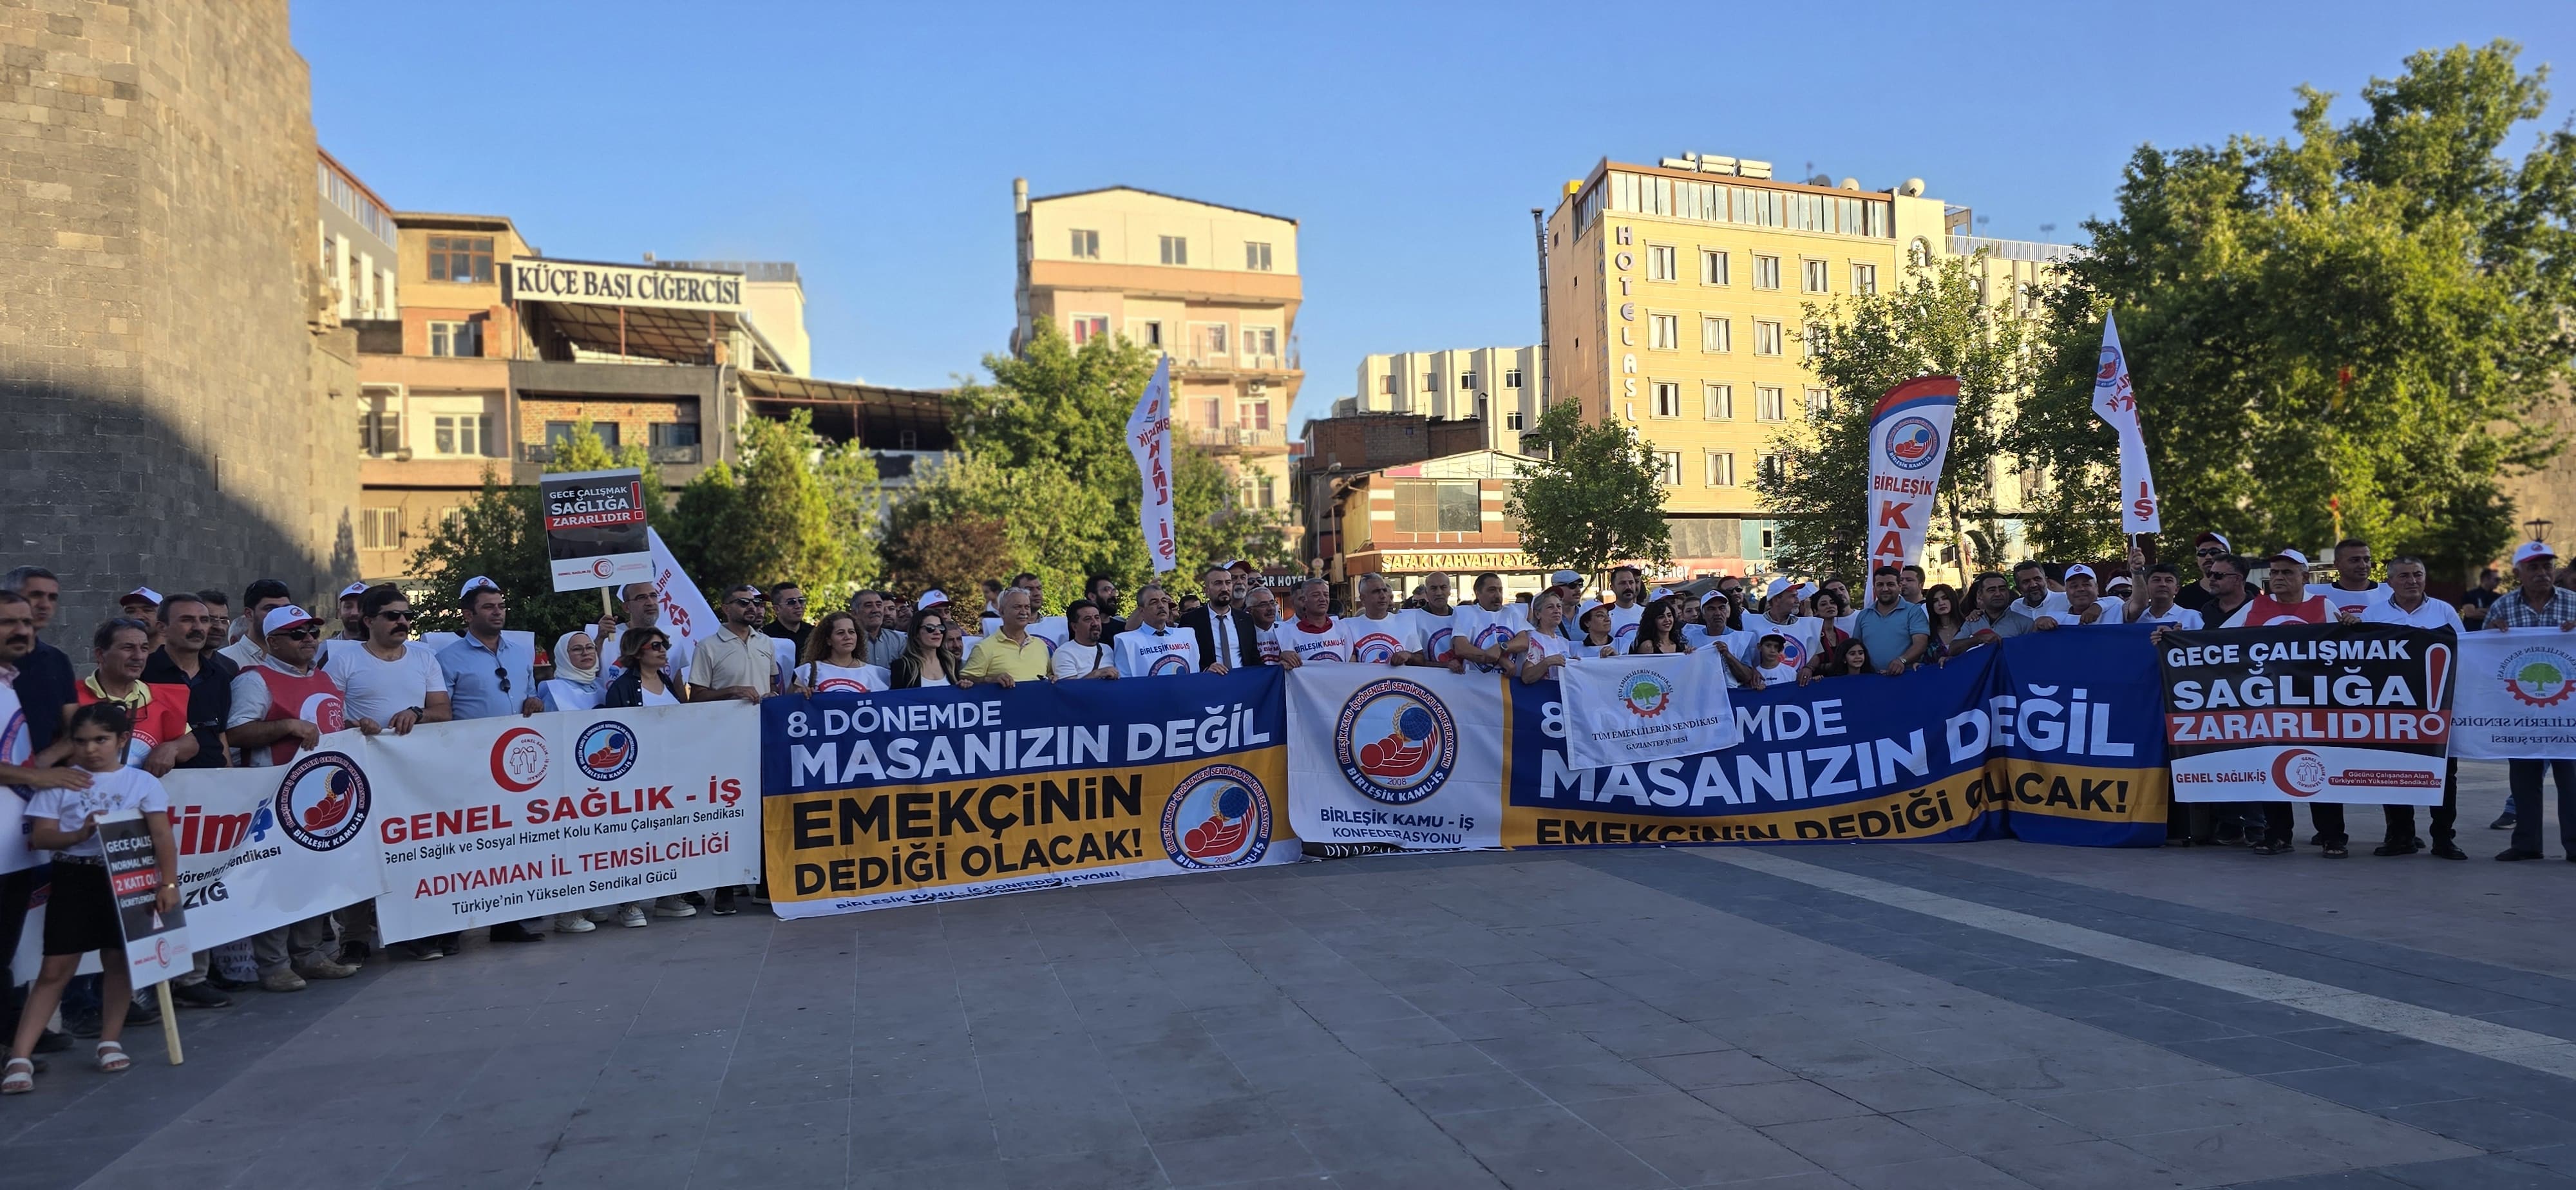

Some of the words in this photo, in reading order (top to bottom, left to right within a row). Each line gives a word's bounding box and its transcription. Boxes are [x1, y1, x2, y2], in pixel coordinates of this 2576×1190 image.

[517, 263, 578, 296] KÜÇE
[583, 271, 634, 299] BAŞI
[638, 271, 741, 305] CİĞERCİSİ
[1616, 226, 1634, 346] HOTEL
[549, 490, 575, 499] GECE
[577, 486, 628, 498] ÇALIŞMAK
[1873, 472, 1935, 498] BİRLEŞİK
[551, 495, 630, 515] SAĞLIĞA
[553, 512, 631, 527] ZARARLIDIR
[1381, 554, 1430, 572] ŞAFAK
[1430, 554, 1501, 567] KAHVALTI
[1139, 643, 1170, 656] BİRLEŞİK
[1168, 641, 1190, 652] KAMU-İŞ
[1294, 640, 1323, 654] BİRLEŞİK
[2166, 643, 2240, 667] GECE
[2249, 639, 2411, 665] ÇALIŞMAK
[1619, 668, 1651, 690] EMEKLİLERİN
[1651, 670, 1674, 694] SENDİKASI
[2173, 666, 2418, 710] SAĞLIĞA
[786, 711, 817, 738] 8.
[824, 700, 1002, 736] DÖNEMDE
[1336, 732, 1351, 765] BİRLEŞİK
[1392, 681, 1437, 706] SENDİKALARI
[1433, 702, 1454, 769] KONFEDERASYONU
[1592, 731, 1611, 741] TÜM
[1612, 723, 1672, 739] EMEKLİLERİN
[1672, 716, 1719, 731] SENDİKASI
[2172, 712, 2421, 742] ZARARLIDIR
[790, 724, 1109, 788] MASANIZIN
[1126, 704, 1271, 762] DEĞİL
[1540, 728, 1929, 808] MASANIZIN
[1945, 683, 2135, 765] DEĞİL
[1626, 739, 1667, 751] GAZİANTEP
[1665, 735, 1689, 747] ŞUBESİ
[609, 760, 632, 779] KAMU-İŞ
[1387, 777, 1407, 786] 2008
[2176, 773, 2213, 784] GENEL
[2331, 777, 2367, 786] Türkiye'nin
[2375, 771, 2412, 780] Çalışandan
[1347, 767, 1395, 801] BİRLEŞİK
[1399, 770, 1445, 802] KAMU-İŞ
[380, 804, 513, 844] GENEL
[526, 786, 675, 825] SAĞLIK
[709, 775, 741, 808] İŞ
[793, 773, 1143, 851] EMEKÇİNİN
[1249, 779, 1270, 839] KONFEDERASYONU
[1320, 806, 1389, 826] BİRLEŞİK
[1392, 813, 1444, 828] KAMU
[1459, 814, 1474, 831] İŞ
[1795, 790, 1954, 839] DEDİĞİ
[293, 829, 330, 850] BİRLEŞİK
[332, 812, 365, 845] KAMU-İŞ
[420, 843, 456, 860] Sağlık
[459, 842, 473, 853] ve
[477, 833, 516, 850] Sosyal
[520, 828, 560, 844] Hizmet
[564, 825, 590, 838] Kolu
[594, 821, 627, 835] Kamu
[631, 814, 690, 833] Çalışanları
[693, 808, 744, 822] Sendikası
[1332, 827, 1462, 845] KONFEDERASYONU
[106, 839, 129, 853] GECE
[111, 858, 141, 871] NORMAL
[414, 860, 543, 899] ADIYAMAN
[551, 854, 573, 877] İL
[579, 831, 729, 872] TEMSİLCİLİĞİ
[794, 841, 948, 896] DEDİĞİ
[960, 827, 1144, 878] OLACAK!
[1215, 855, 1233, 864] 2008
[116, 880, 124, 892] 2
[124, 876, 146, 890] KATI
[527, 883, 585, 902] Yükselen
[589, 874, 641, 892] Sendikal
[646, 869, 677, 884] Gücü
